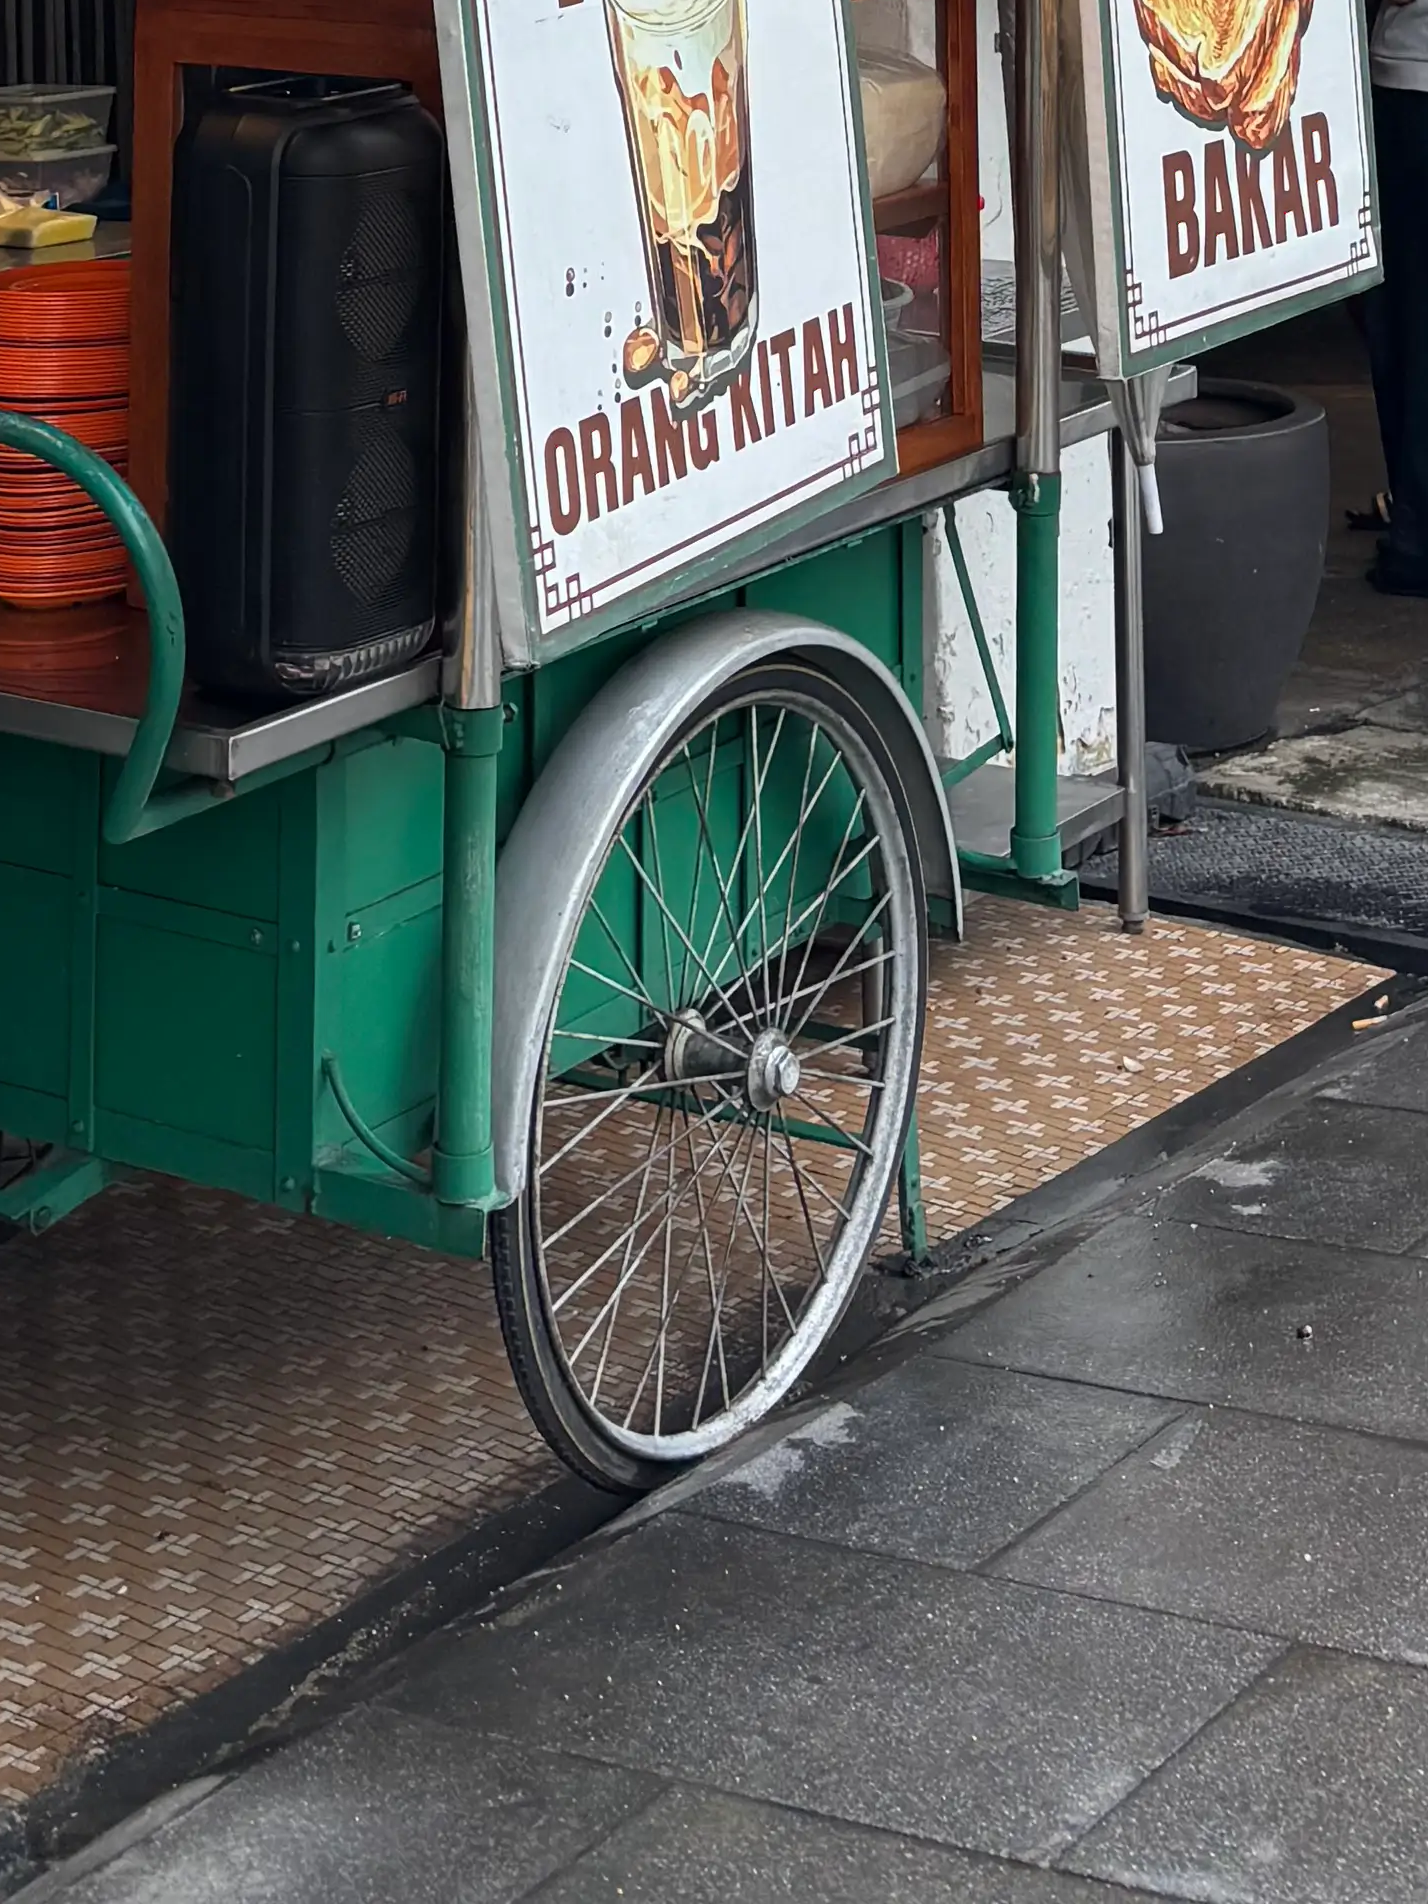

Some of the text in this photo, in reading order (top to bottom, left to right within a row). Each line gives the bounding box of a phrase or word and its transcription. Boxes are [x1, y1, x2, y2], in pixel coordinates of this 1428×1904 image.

[1161, 110, 1341, 280] BAKAR
[544, 300, 860, 536] ORANG KITAH
